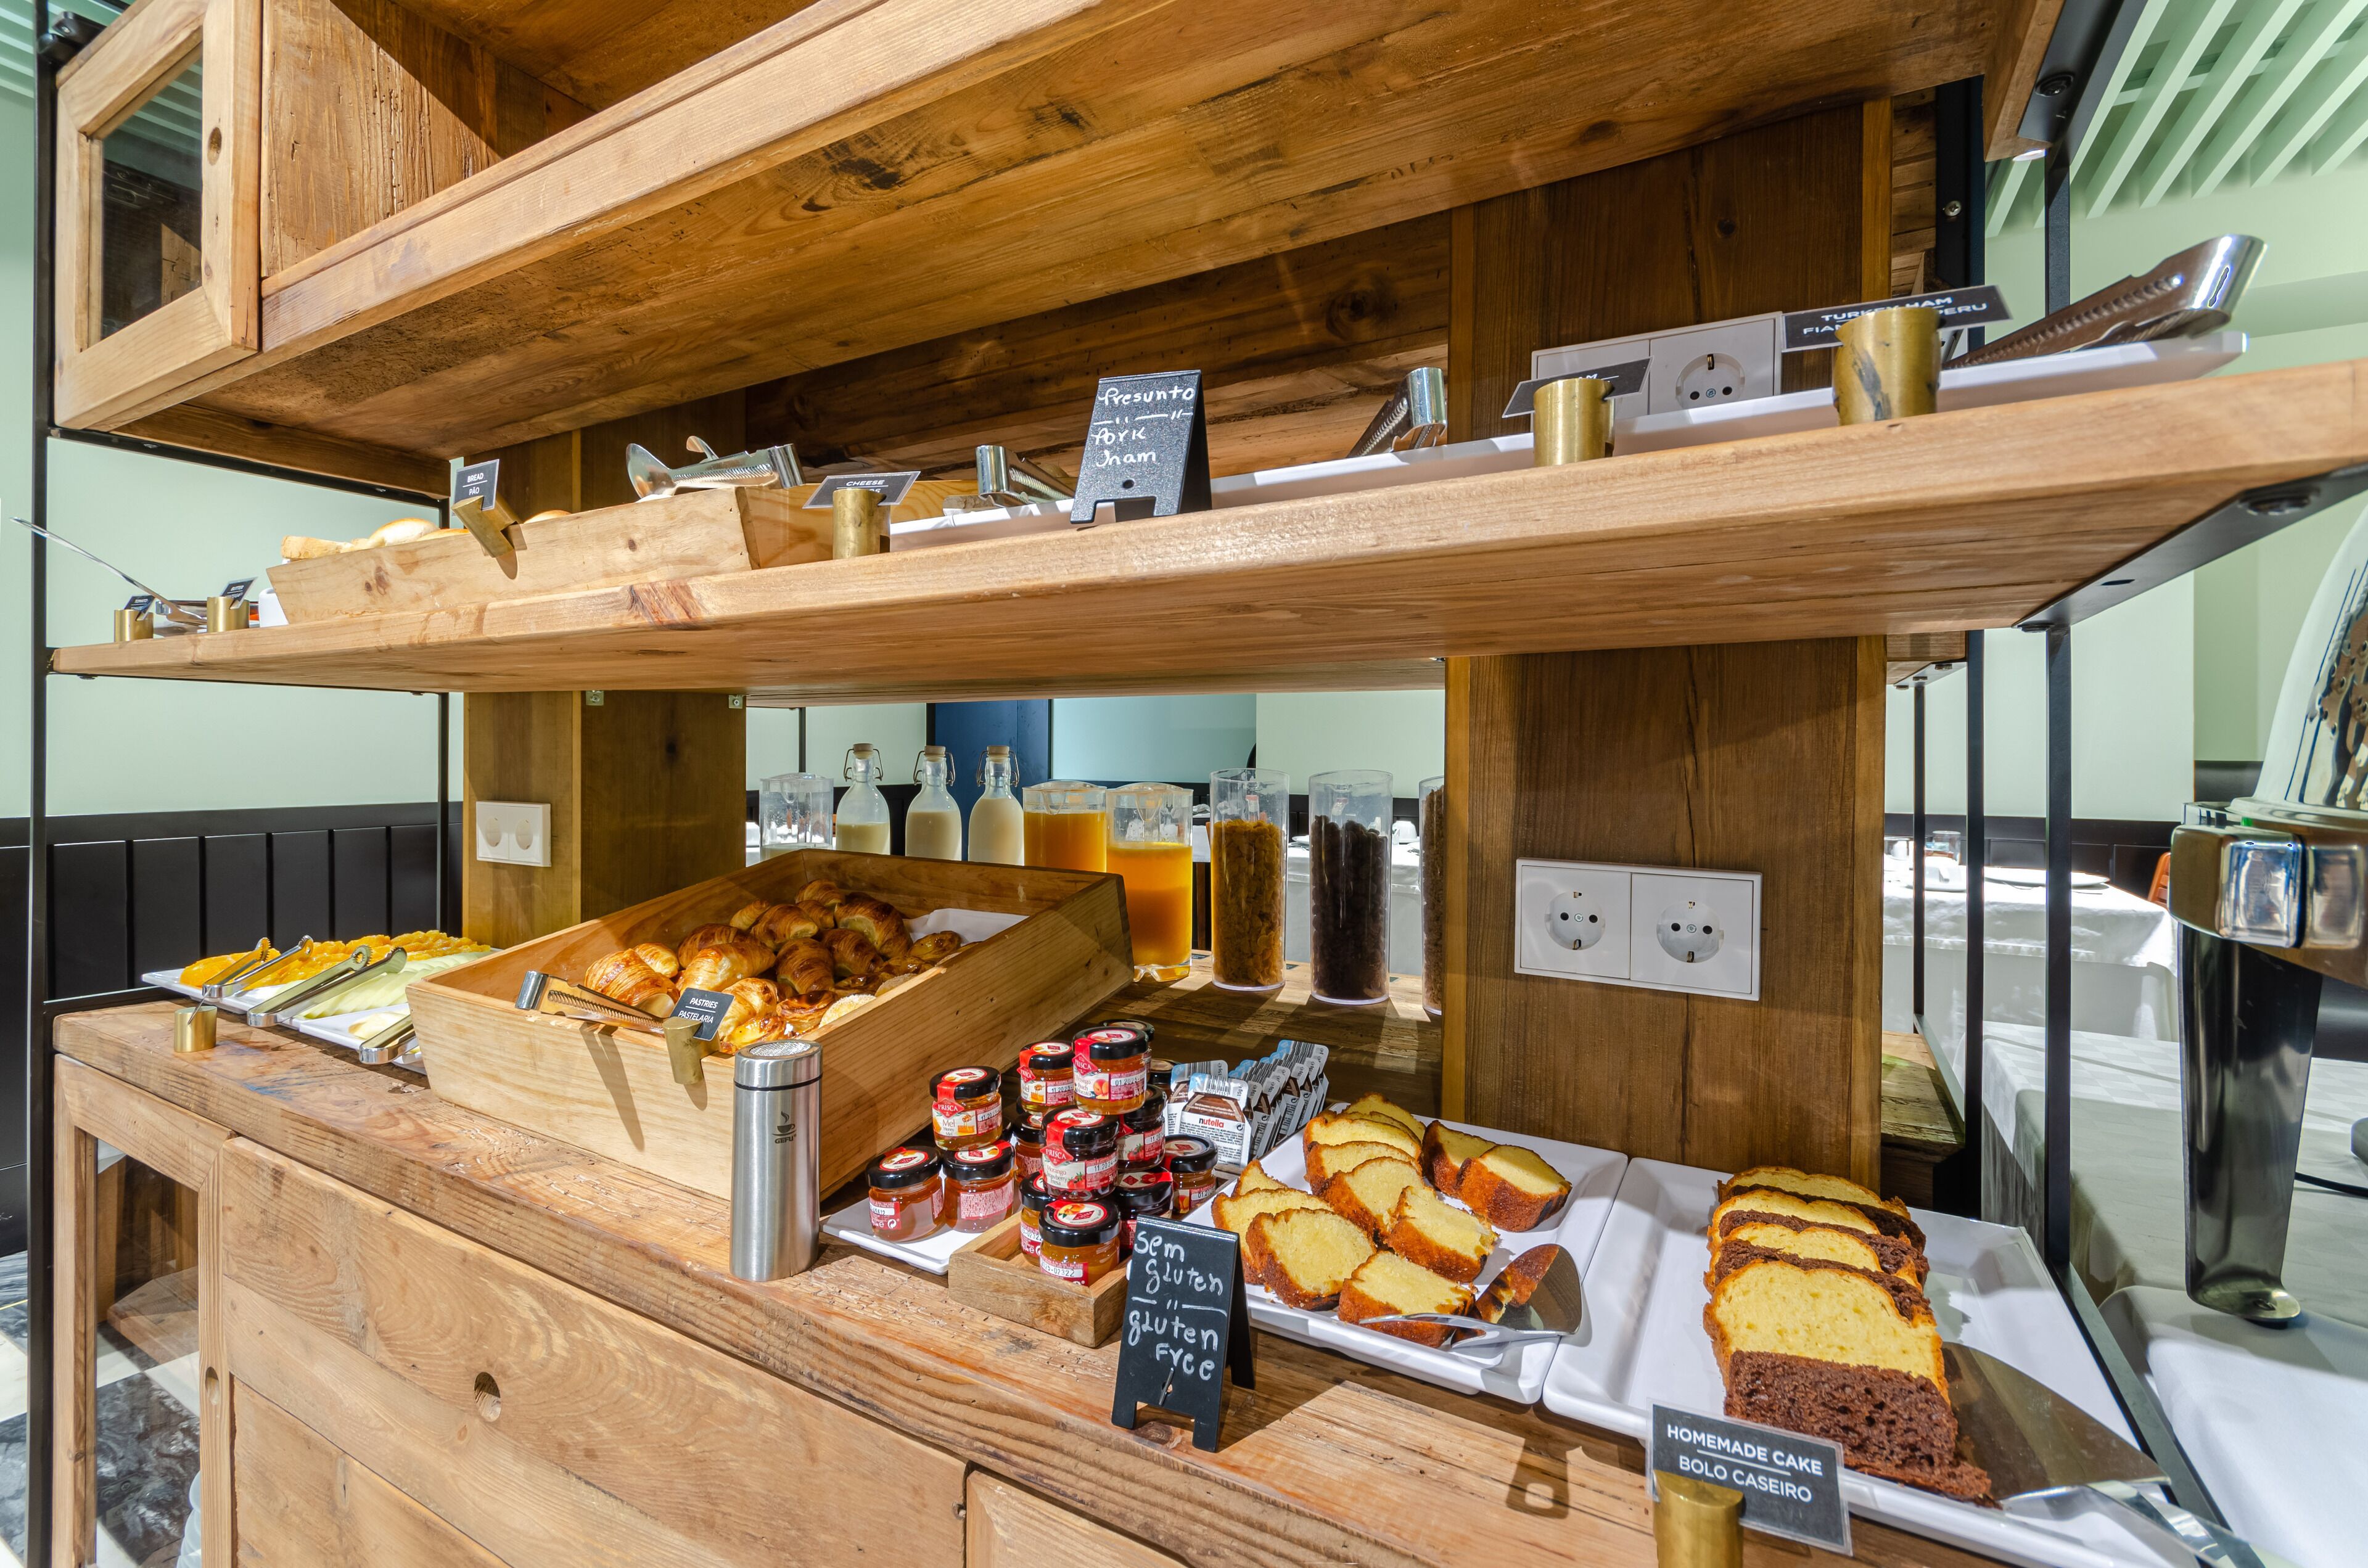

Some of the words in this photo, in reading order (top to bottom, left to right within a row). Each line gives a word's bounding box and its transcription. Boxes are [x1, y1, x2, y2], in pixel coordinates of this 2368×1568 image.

[1905, 297, 1954, 308] HAM
[1098, 385, 1194, 406] Presunto
[467, 472, 484, 483] BREAD
[469, 486, 480, 496] PÃO
[689, 997, 718, 1009] PASTRIES
[678, 1010, 714, 1024] PASTELARIA
[1075, 1059, 1092, 1070] PRISCA
[938, 1104, 958, 1112] PRISCA
[942, 1119, 955, 1127] Mel
[1199, 1118, 1224, 1128] nutella
[775, 1135, 794, 1144] GEFU
[1045, 1148, 1066, 1160] PRISCA
[1667, 1424, 1769, 1463] HOMEMADE
[1773, 1450, 1823, 1477] CAKE
[1679, 1455, 1728, 1481] BOLO
[1732, 1469, 1812, 1504] CASEIRO
